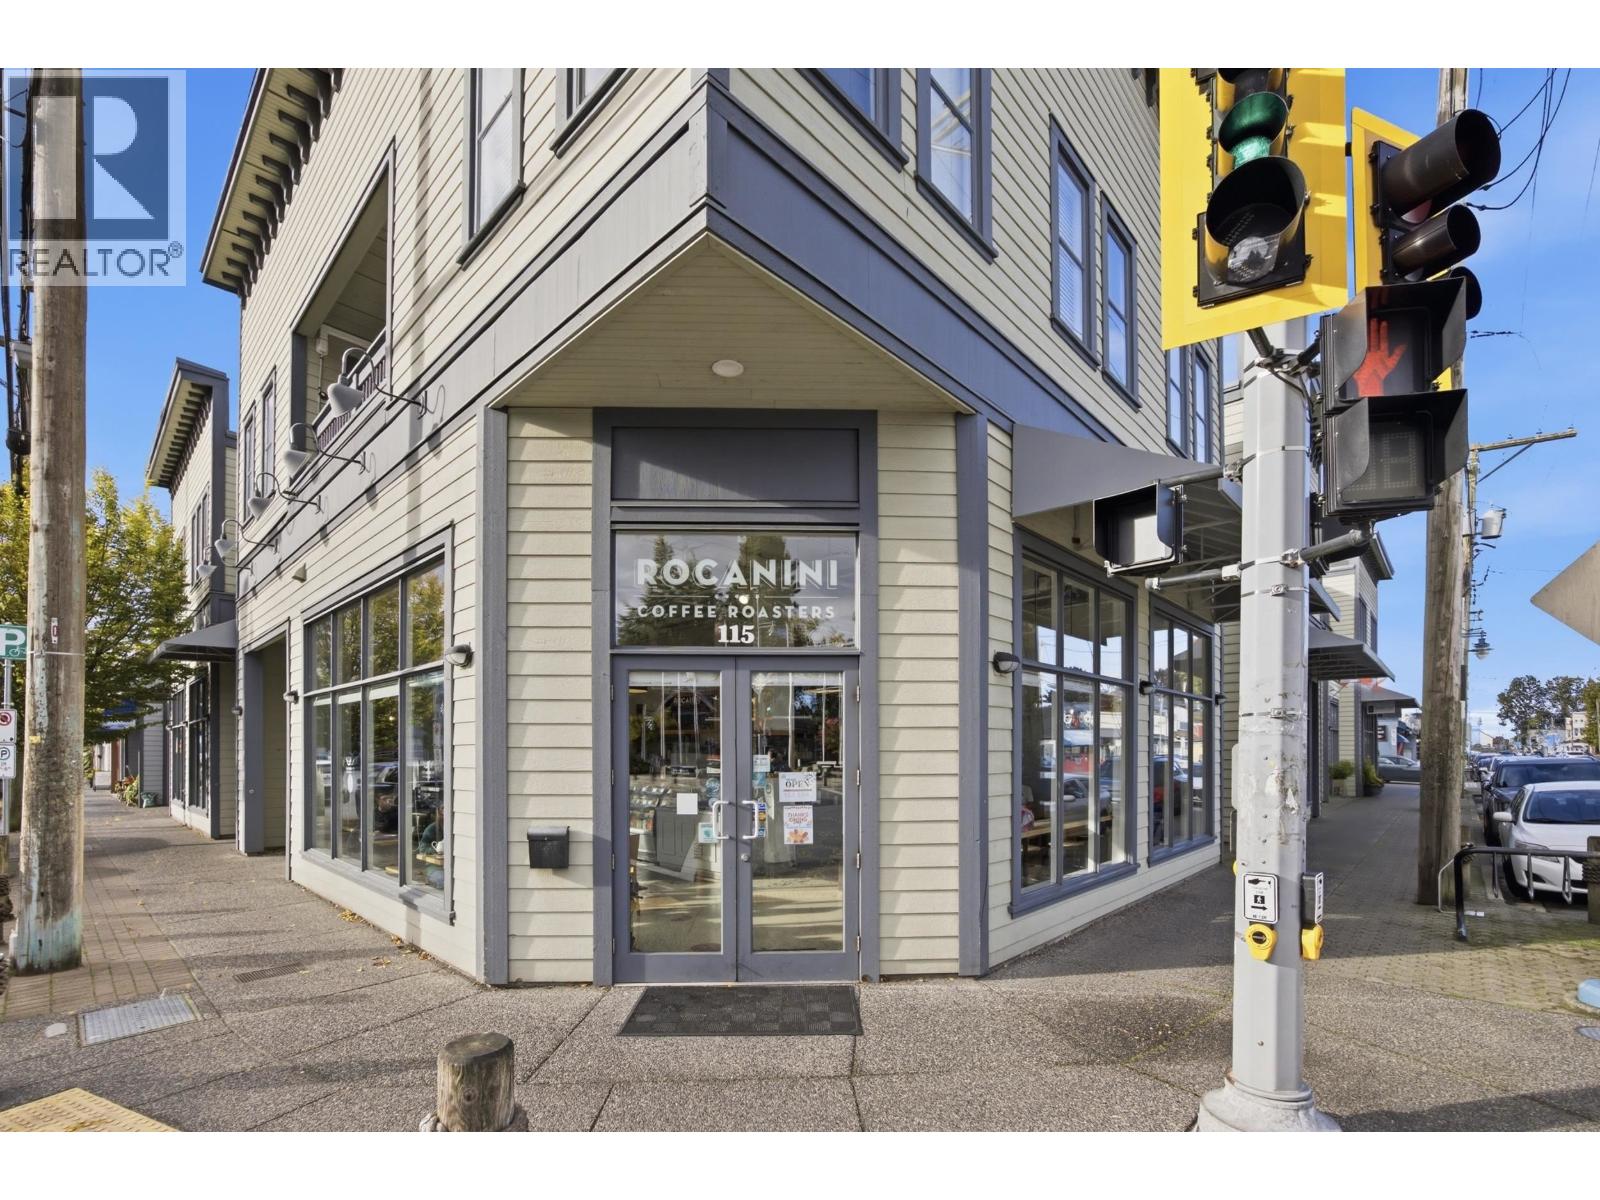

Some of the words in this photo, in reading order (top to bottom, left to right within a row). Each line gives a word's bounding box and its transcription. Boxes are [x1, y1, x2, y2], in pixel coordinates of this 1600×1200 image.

[635, 558, 838, 588] ROCANINI
[637, 605, 717, 618] COFFEE
[728, 605, 835, 619] ROASTERS
[718, 624, 755, 643] 115
